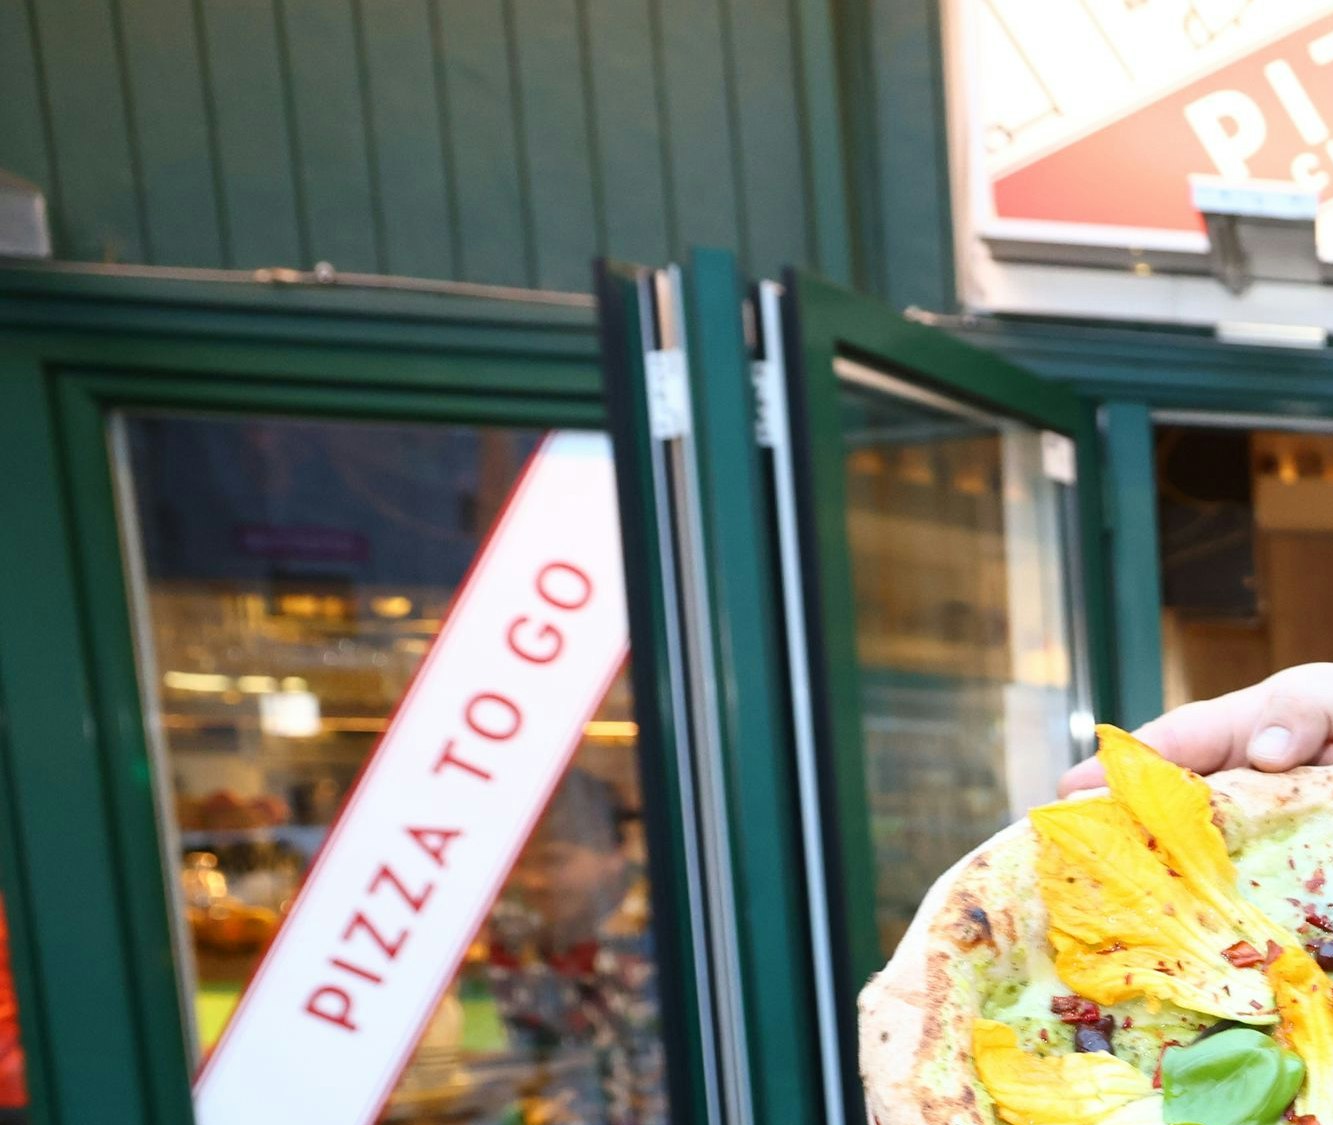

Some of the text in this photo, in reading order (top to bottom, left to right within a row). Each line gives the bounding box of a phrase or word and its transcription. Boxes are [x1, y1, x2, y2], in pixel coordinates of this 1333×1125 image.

[301, 559, 594, 1033] PIZZA TO GO
